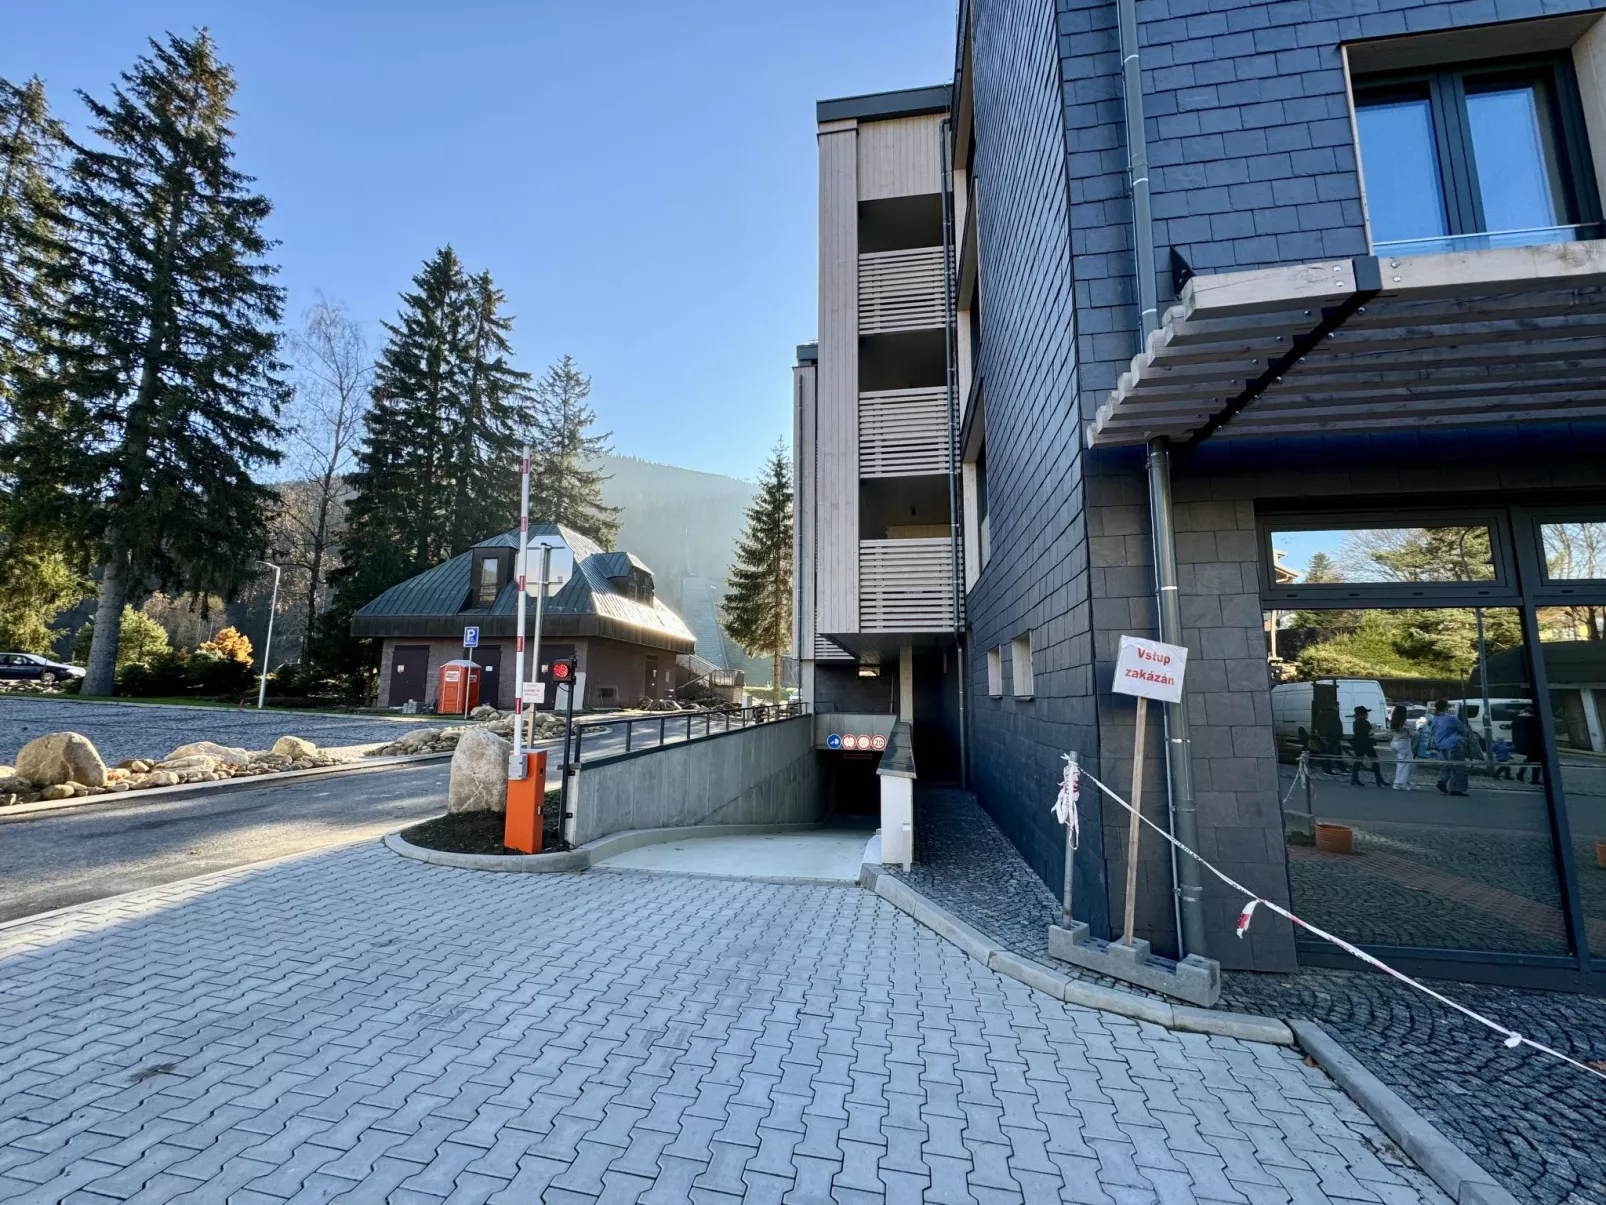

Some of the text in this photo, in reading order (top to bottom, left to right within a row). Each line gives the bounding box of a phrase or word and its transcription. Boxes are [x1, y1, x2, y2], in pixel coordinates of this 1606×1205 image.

[467, 629, 475, 641] P
[1138, 648, 1171, 666] Vstup
[1125, 669, 1175, 685] zakázán
